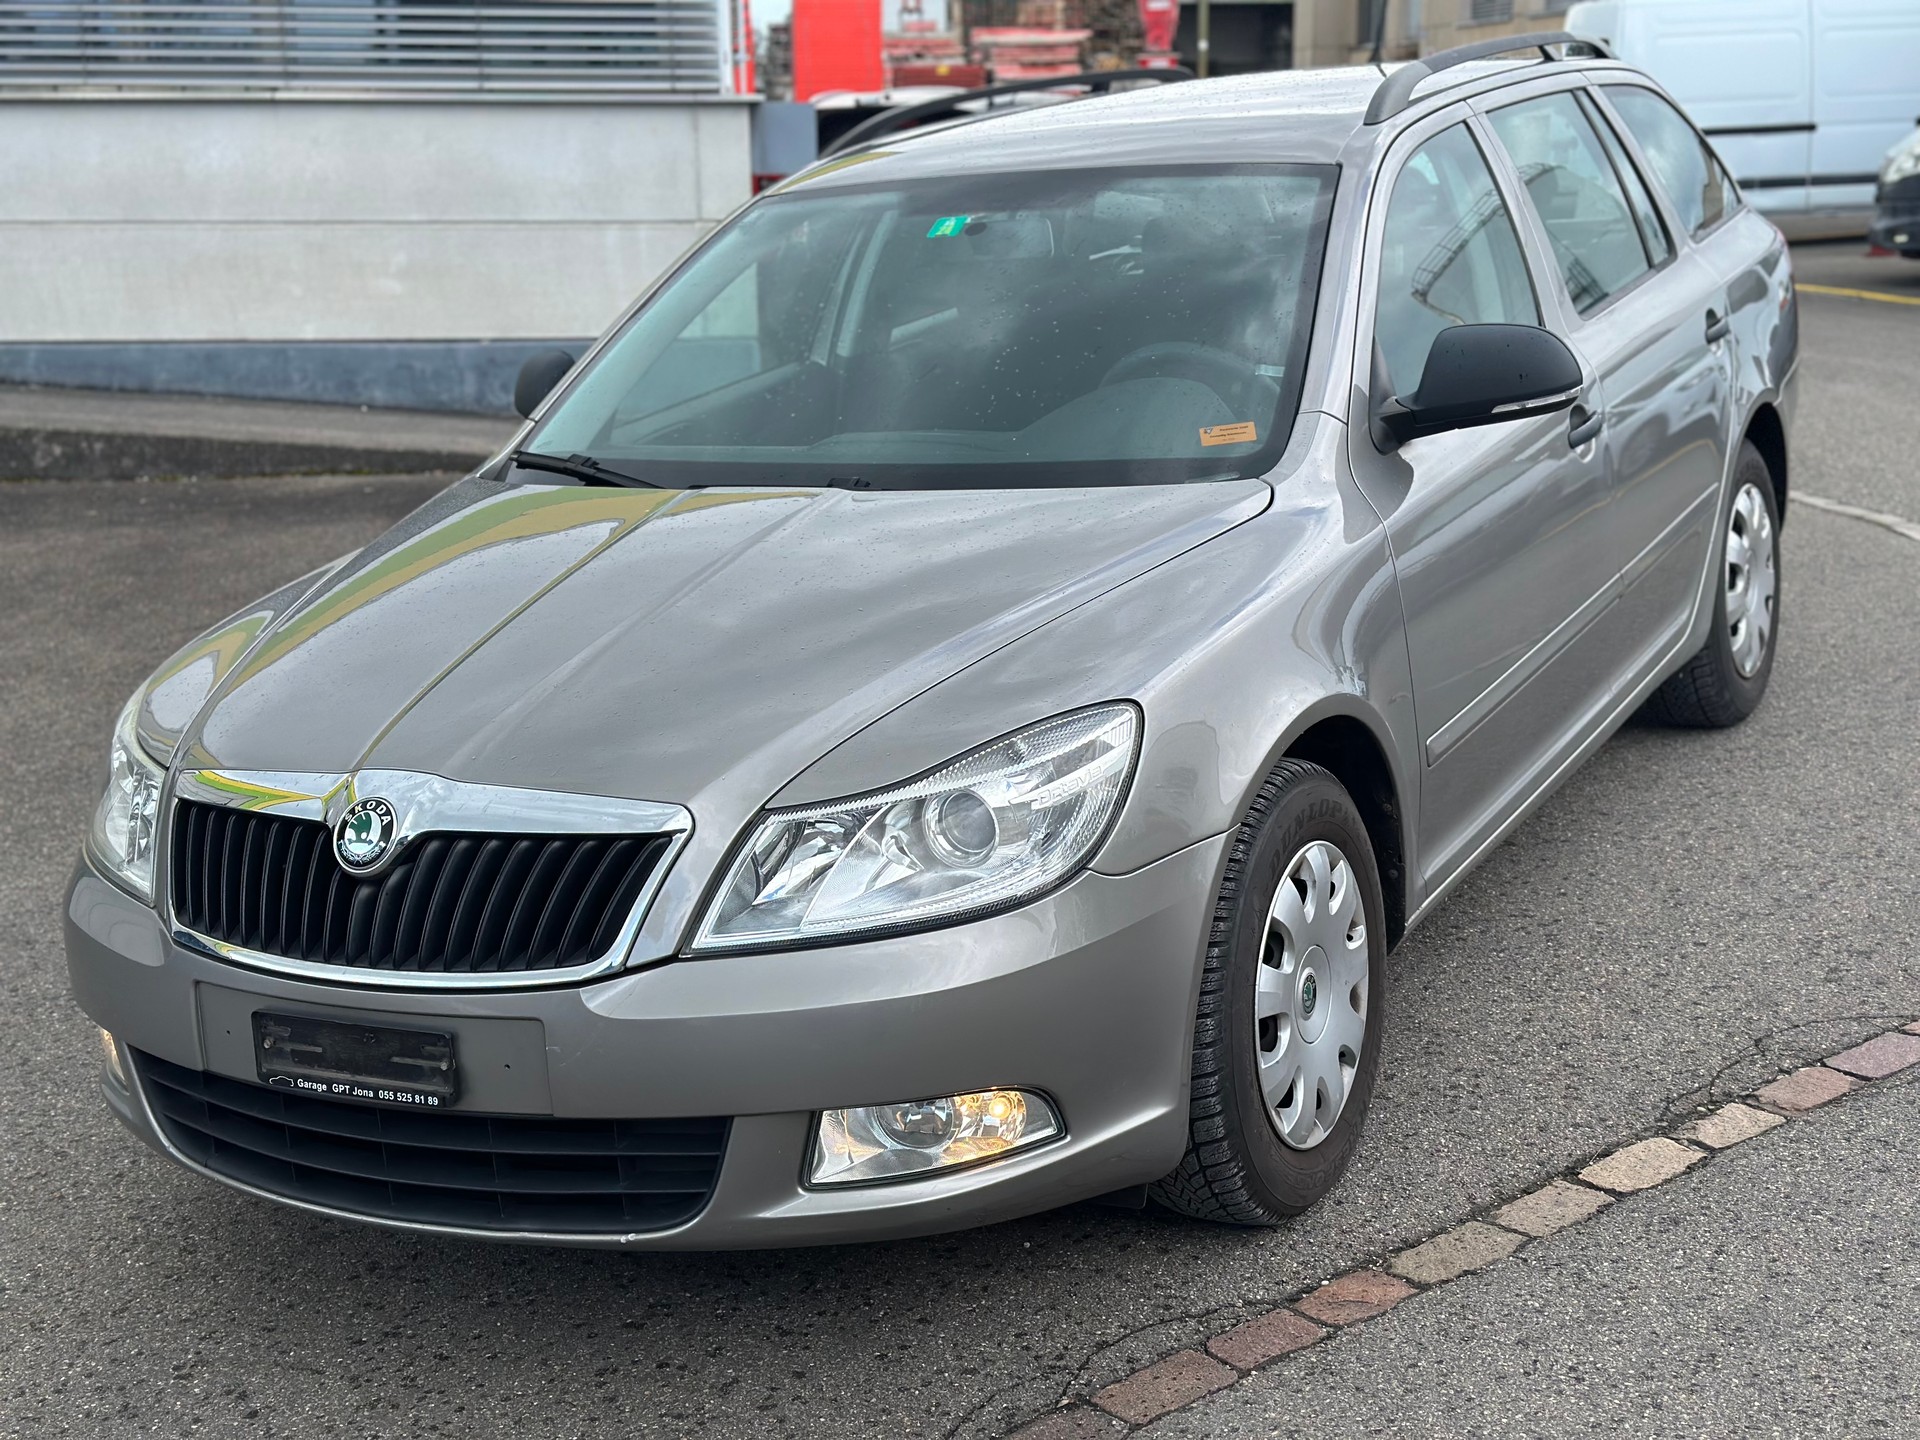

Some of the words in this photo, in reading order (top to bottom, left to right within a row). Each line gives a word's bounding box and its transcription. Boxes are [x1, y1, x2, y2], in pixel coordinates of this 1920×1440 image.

[1269, 798, 1343, 876] DUNLOP
[297, 1078, 327, 1092] Garage
[332, 1083, 350, 1095] GPT
[352, 1086, 374, 1098] Jona
[378, 1090, 395, 1100] 055
[396, 1092, 413, 1103] 525
[414, 1094, 425, 1104] 81
[427, 1096, 439, 1106] 89
